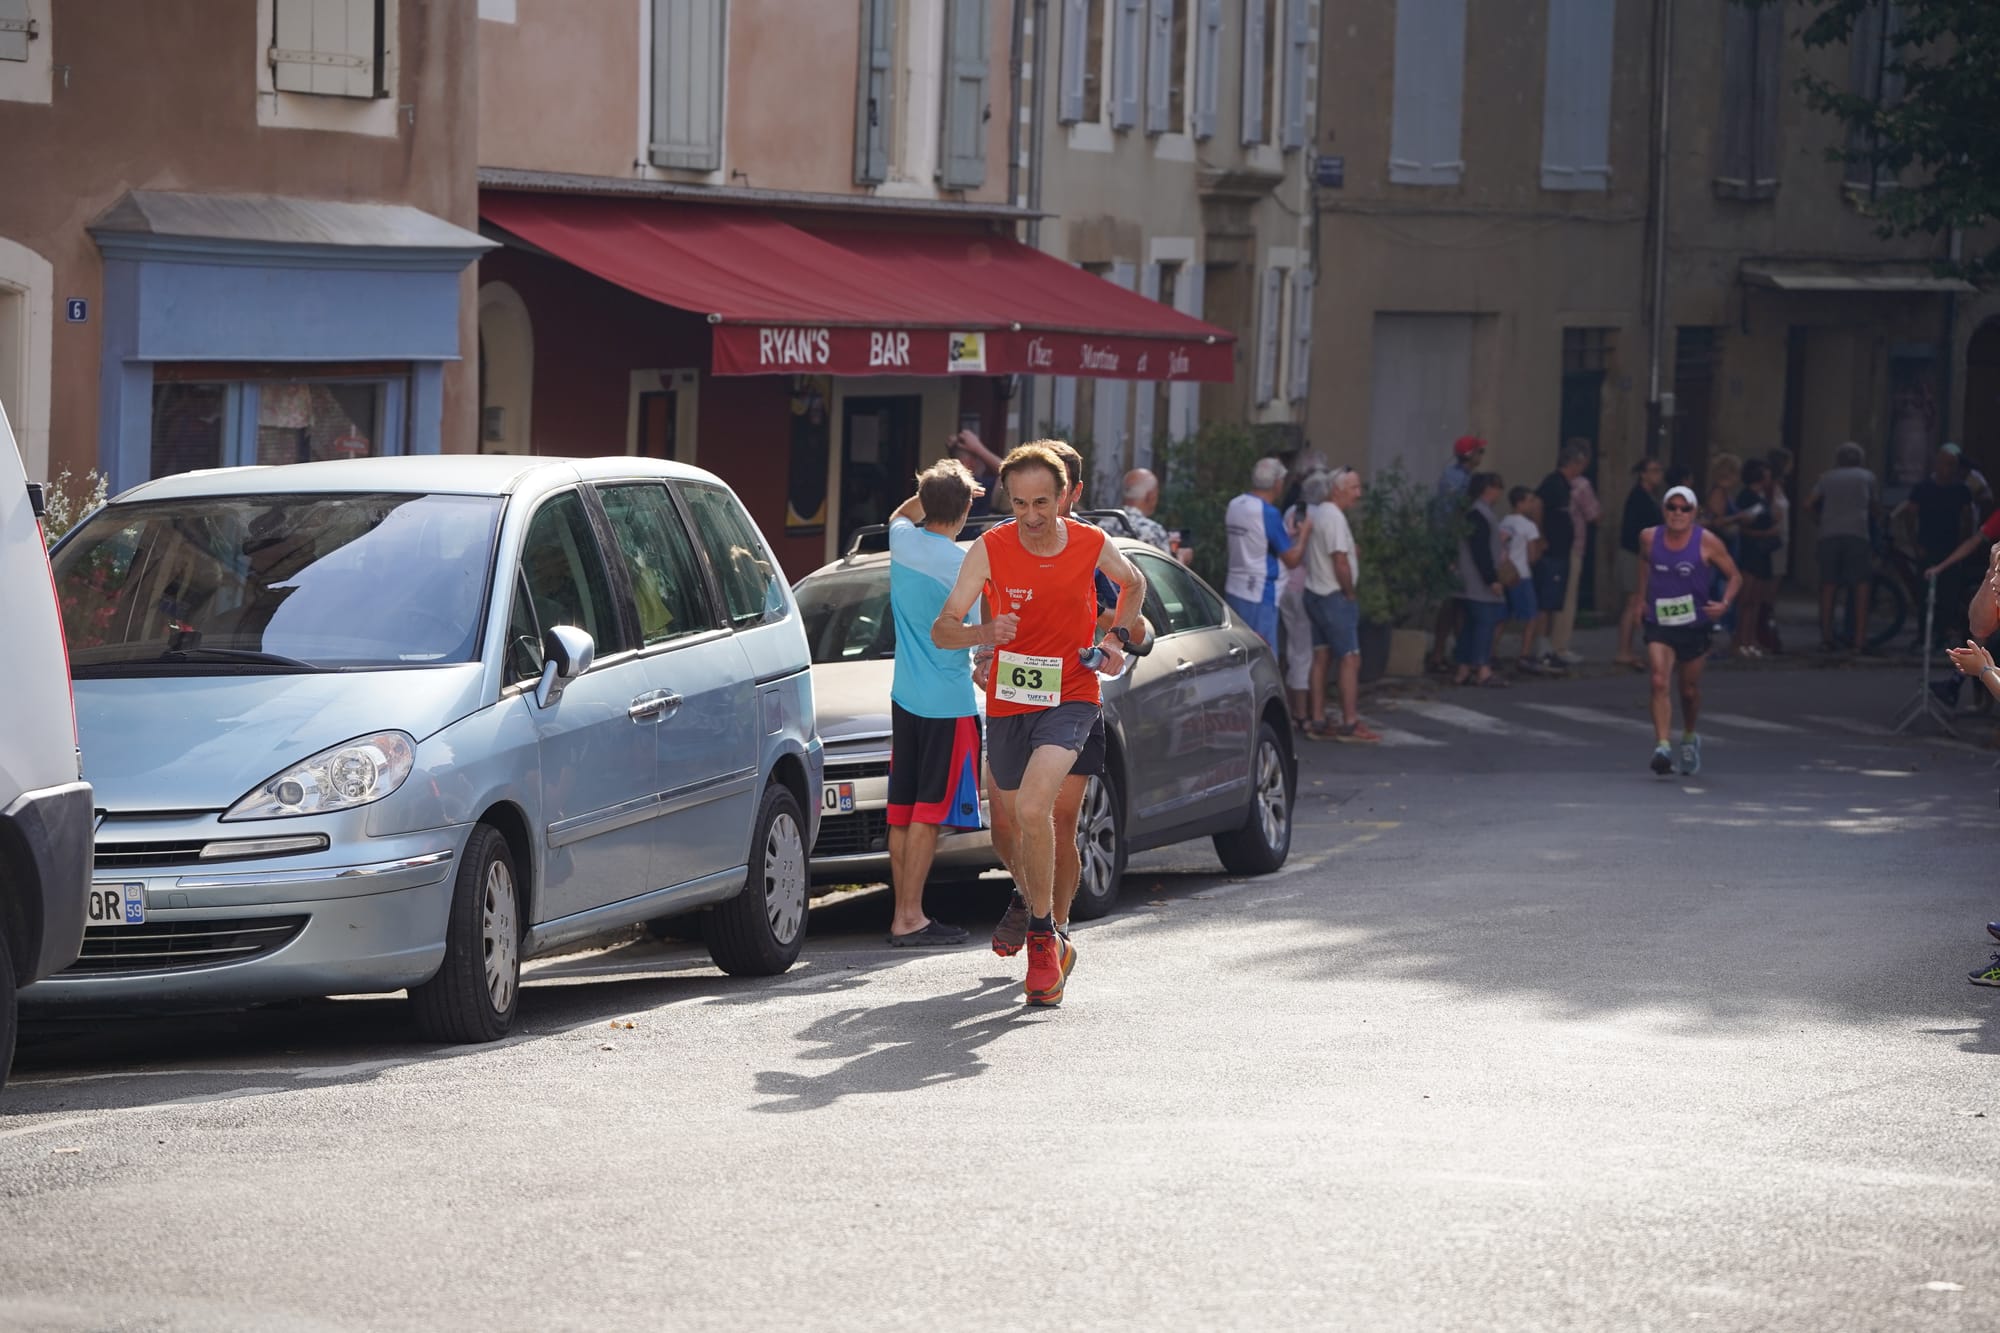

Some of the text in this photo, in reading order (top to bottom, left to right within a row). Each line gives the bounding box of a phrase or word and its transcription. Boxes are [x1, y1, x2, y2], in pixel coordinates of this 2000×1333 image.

[74, 302, 81, 318] 6
[760, 328, 830, 365] RYAN'S
[869, 332, 910, 367] BAR
[1027, 338, 1053, 367] Chez
[1137, 351, 1148, 372] et
[1662, 603, 1689, 616] 123
[1012, 667, 1043, 689] 63
[841, 798, 851, 808] 48
[89, 891, 120, 920] QR
[127, 904, 141, 917] 59
